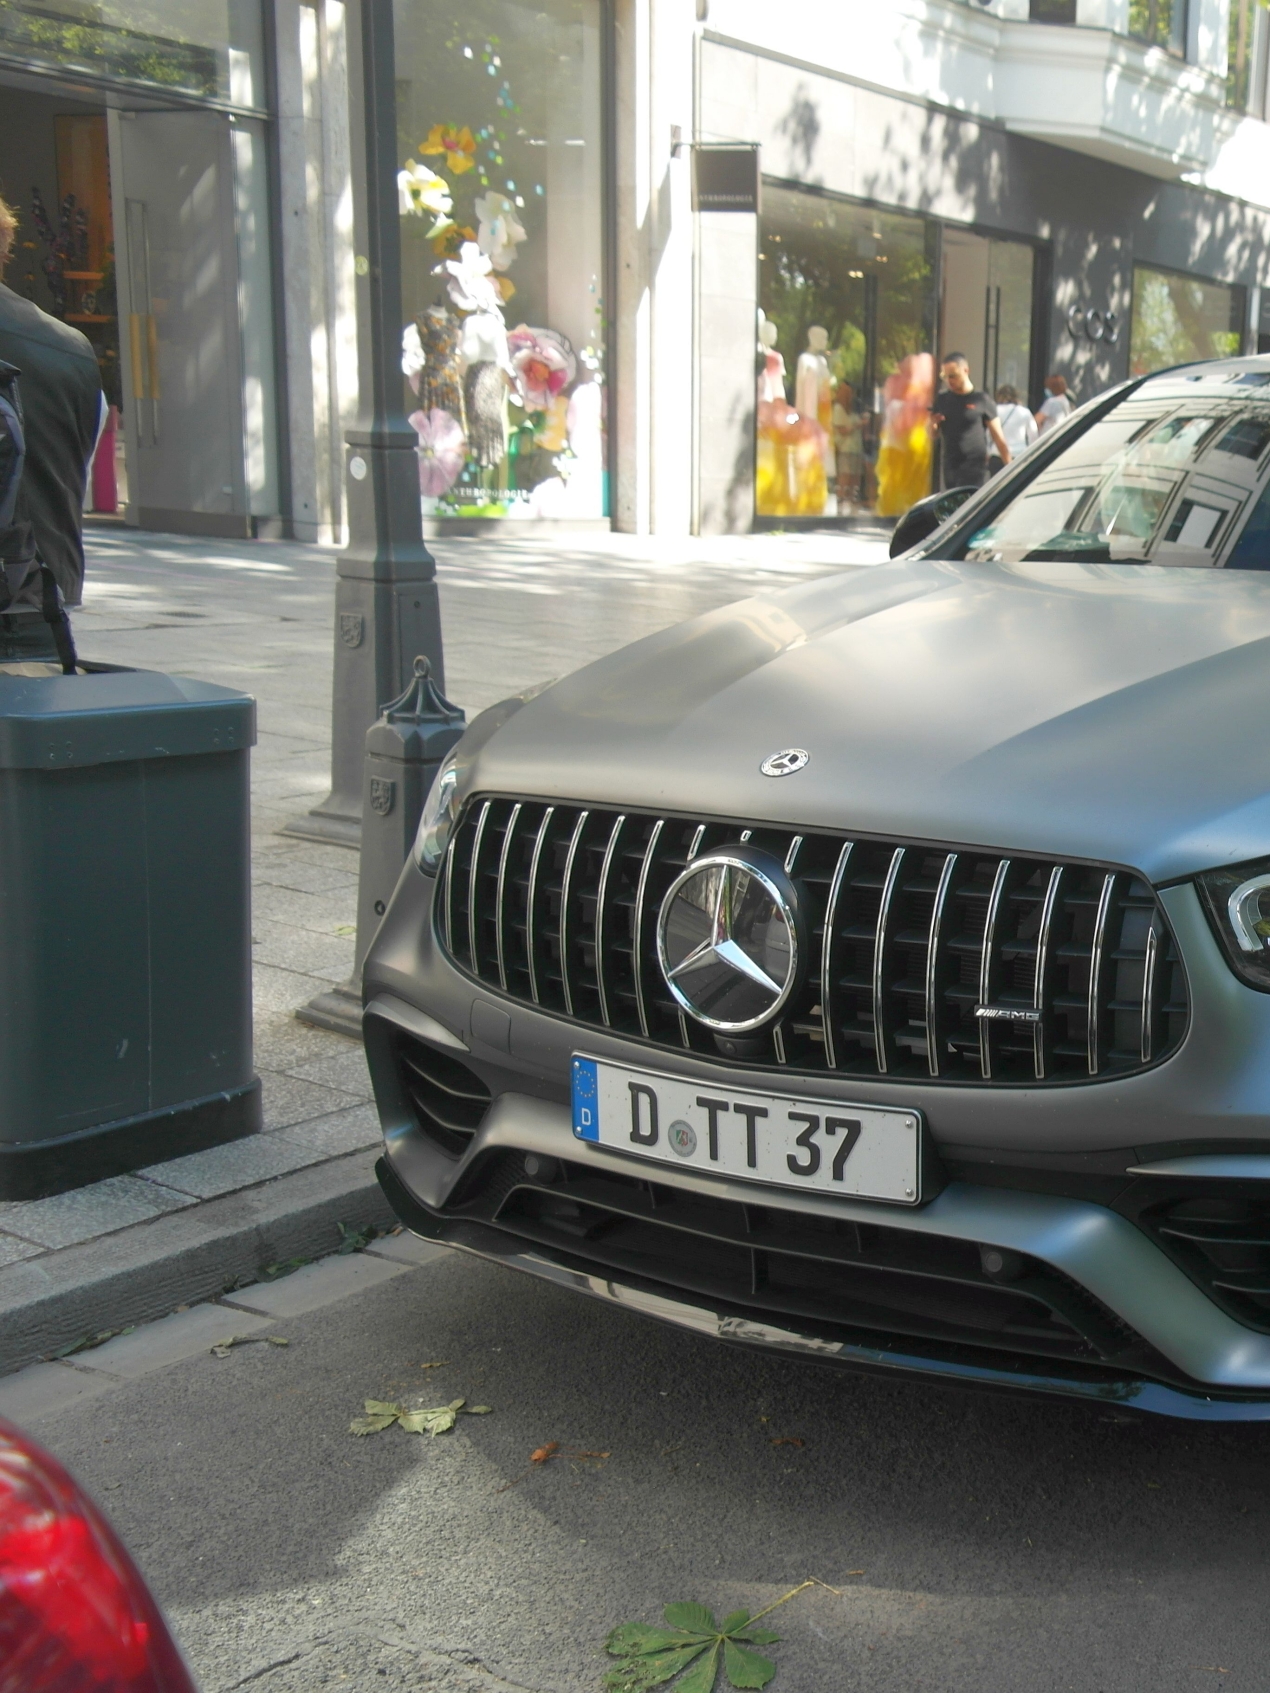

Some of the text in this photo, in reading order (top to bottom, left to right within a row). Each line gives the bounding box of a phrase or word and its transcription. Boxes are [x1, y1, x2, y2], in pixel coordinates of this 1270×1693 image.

[1067, 304, 1118, 343] COS
[996, 1009, 1040, 1021] AMG
[581, 1107, 591, 1126] D
[628, 1080, 658, 1147] D
[696, 1095, 769, 1169] TT
[786, 1110, 862, 1182] 37
